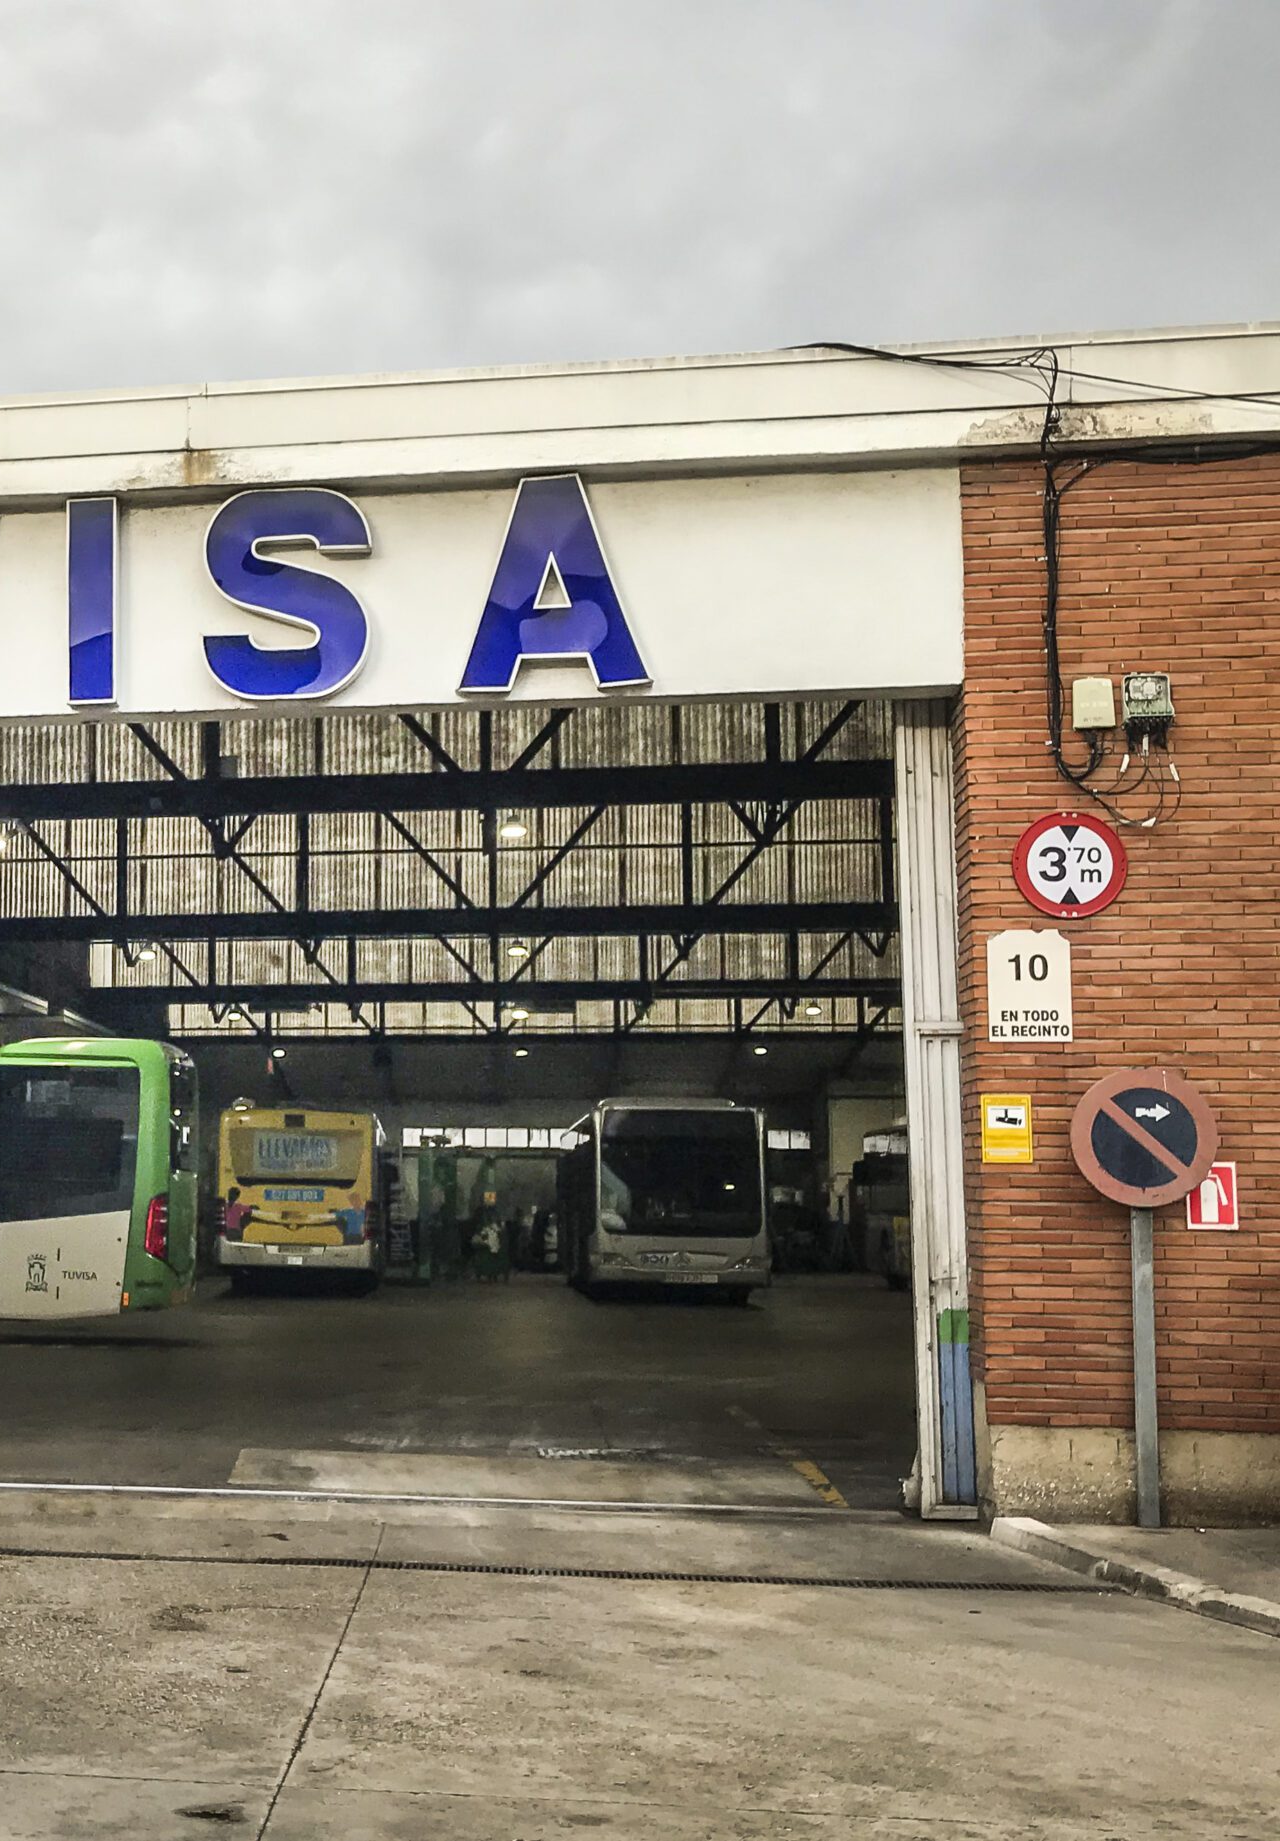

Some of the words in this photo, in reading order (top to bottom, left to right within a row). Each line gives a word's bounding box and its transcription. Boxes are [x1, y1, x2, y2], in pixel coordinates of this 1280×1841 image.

[1080, 868, 1102, 883] m
[1008, 954, 1049, 981] 10
[1001, 1010, 1019, 1022] EN
[1022, 1009, 1059, 1022] TODO
[991, 1025, 1008, 1037] EL
[1011, 1024, 1070, 1037] RECINTO
[61, 1270, 98, 1281] TUVISA
